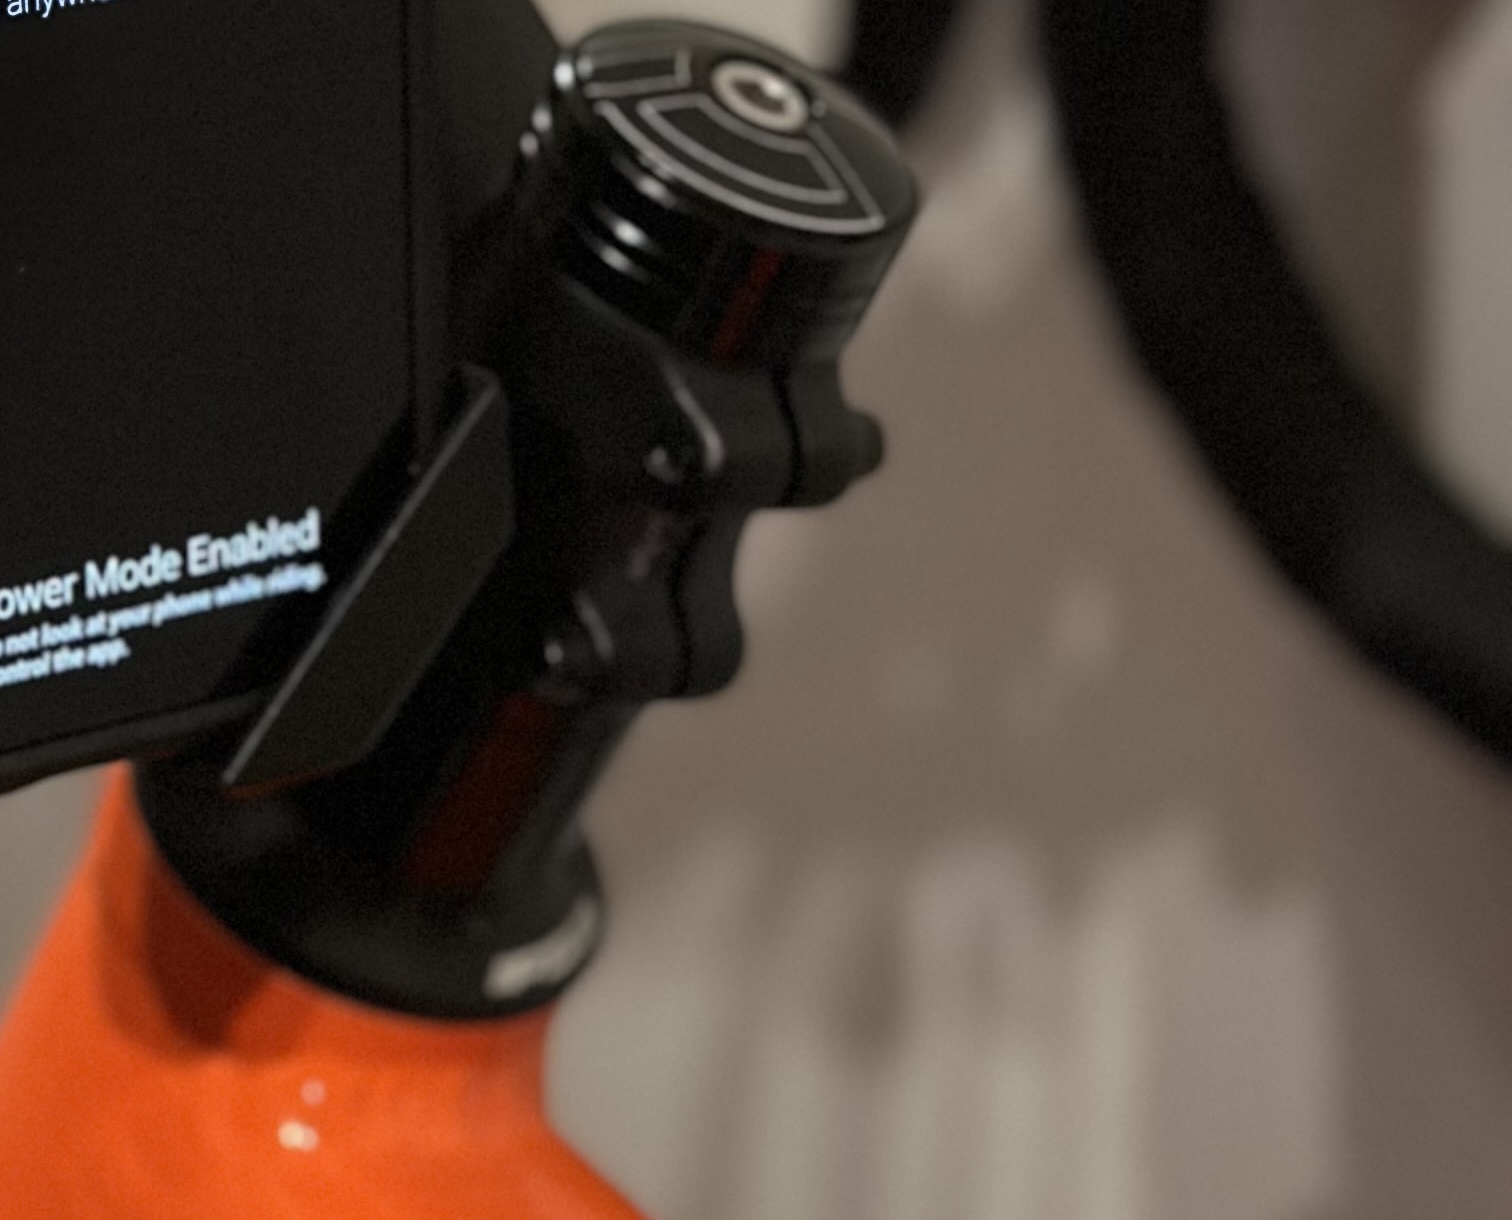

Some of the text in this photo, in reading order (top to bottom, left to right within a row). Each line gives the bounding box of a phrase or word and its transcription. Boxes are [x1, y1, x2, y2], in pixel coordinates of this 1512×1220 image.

[84, 542, 183, 600] Mode
[186, 506, 322, 577] Enabled
[5, 626, 38, 655] not
